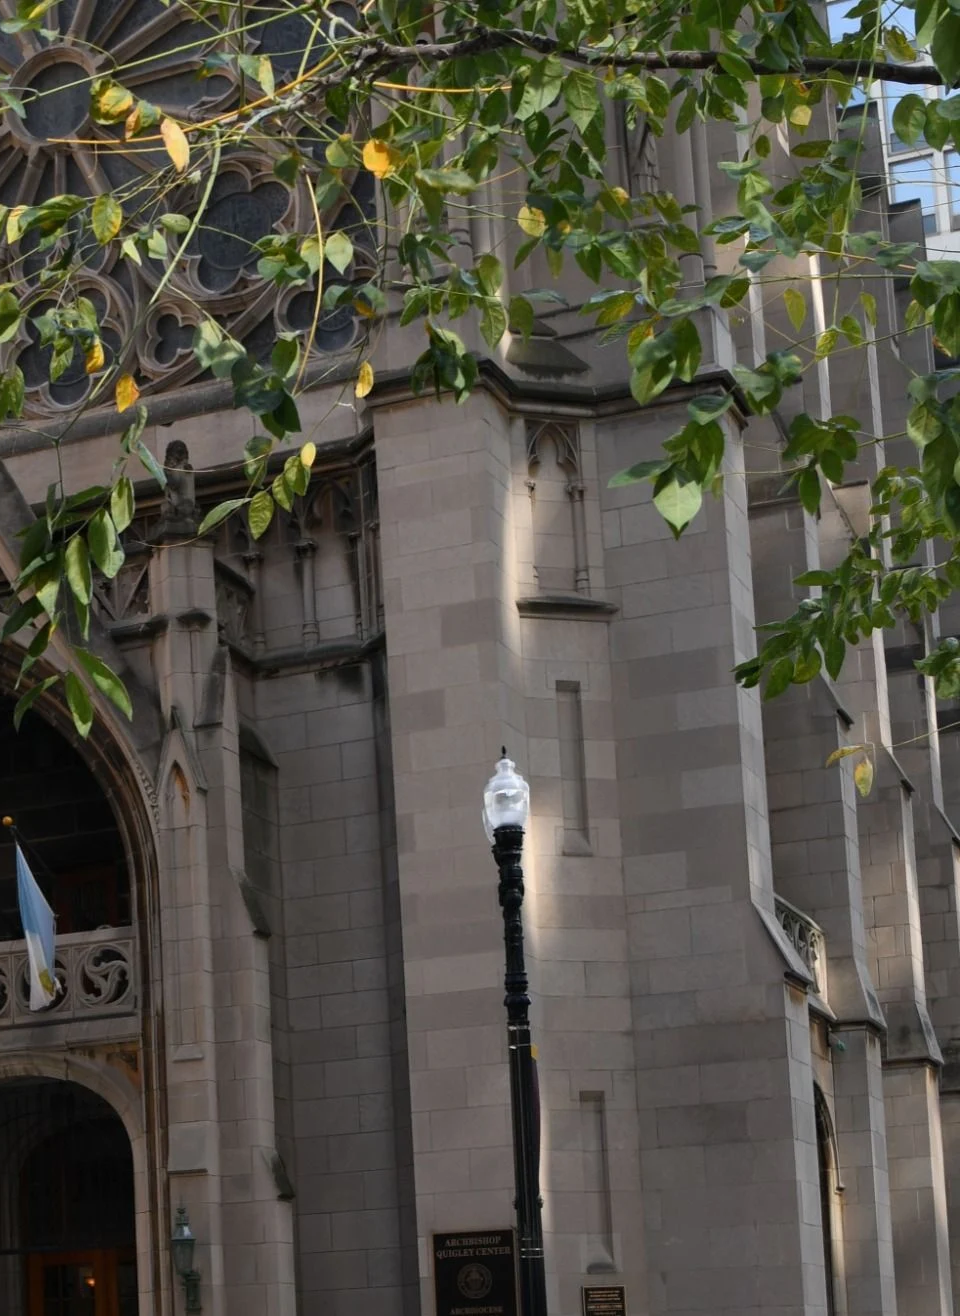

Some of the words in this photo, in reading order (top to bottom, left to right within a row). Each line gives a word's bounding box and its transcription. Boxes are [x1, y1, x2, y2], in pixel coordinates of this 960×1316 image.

[444, 1236, 502, 1247] ARCHBISHOP
[436, 1248, 475, 1260] QUIGLEY
[476, 1246, 512, 1257] CENTER
